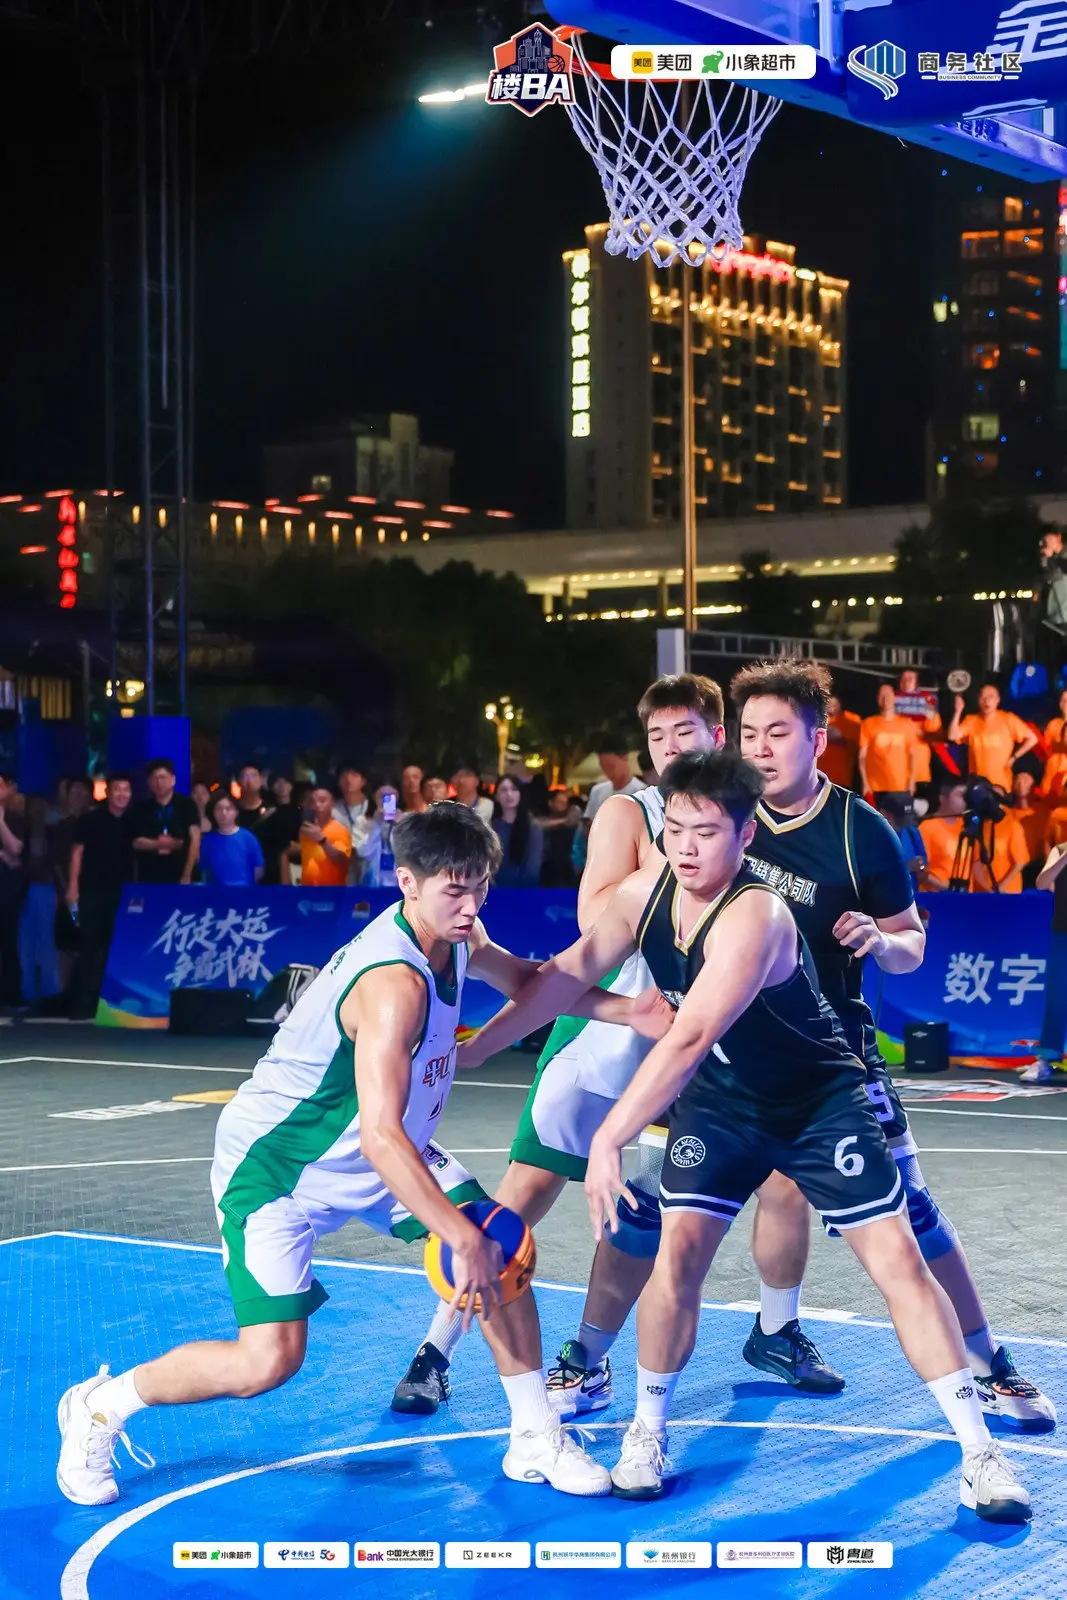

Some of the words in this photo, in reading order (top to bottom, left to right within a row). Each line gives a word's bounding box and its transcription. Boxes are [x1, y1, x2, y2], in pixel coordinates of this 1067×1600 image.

[148, 906, 286, 954] 行走大运
[943, 952, 1047, 1006] 数字
[866, 1080, 896, 1122] 5
[834, 1135, 865, 1177] 6
